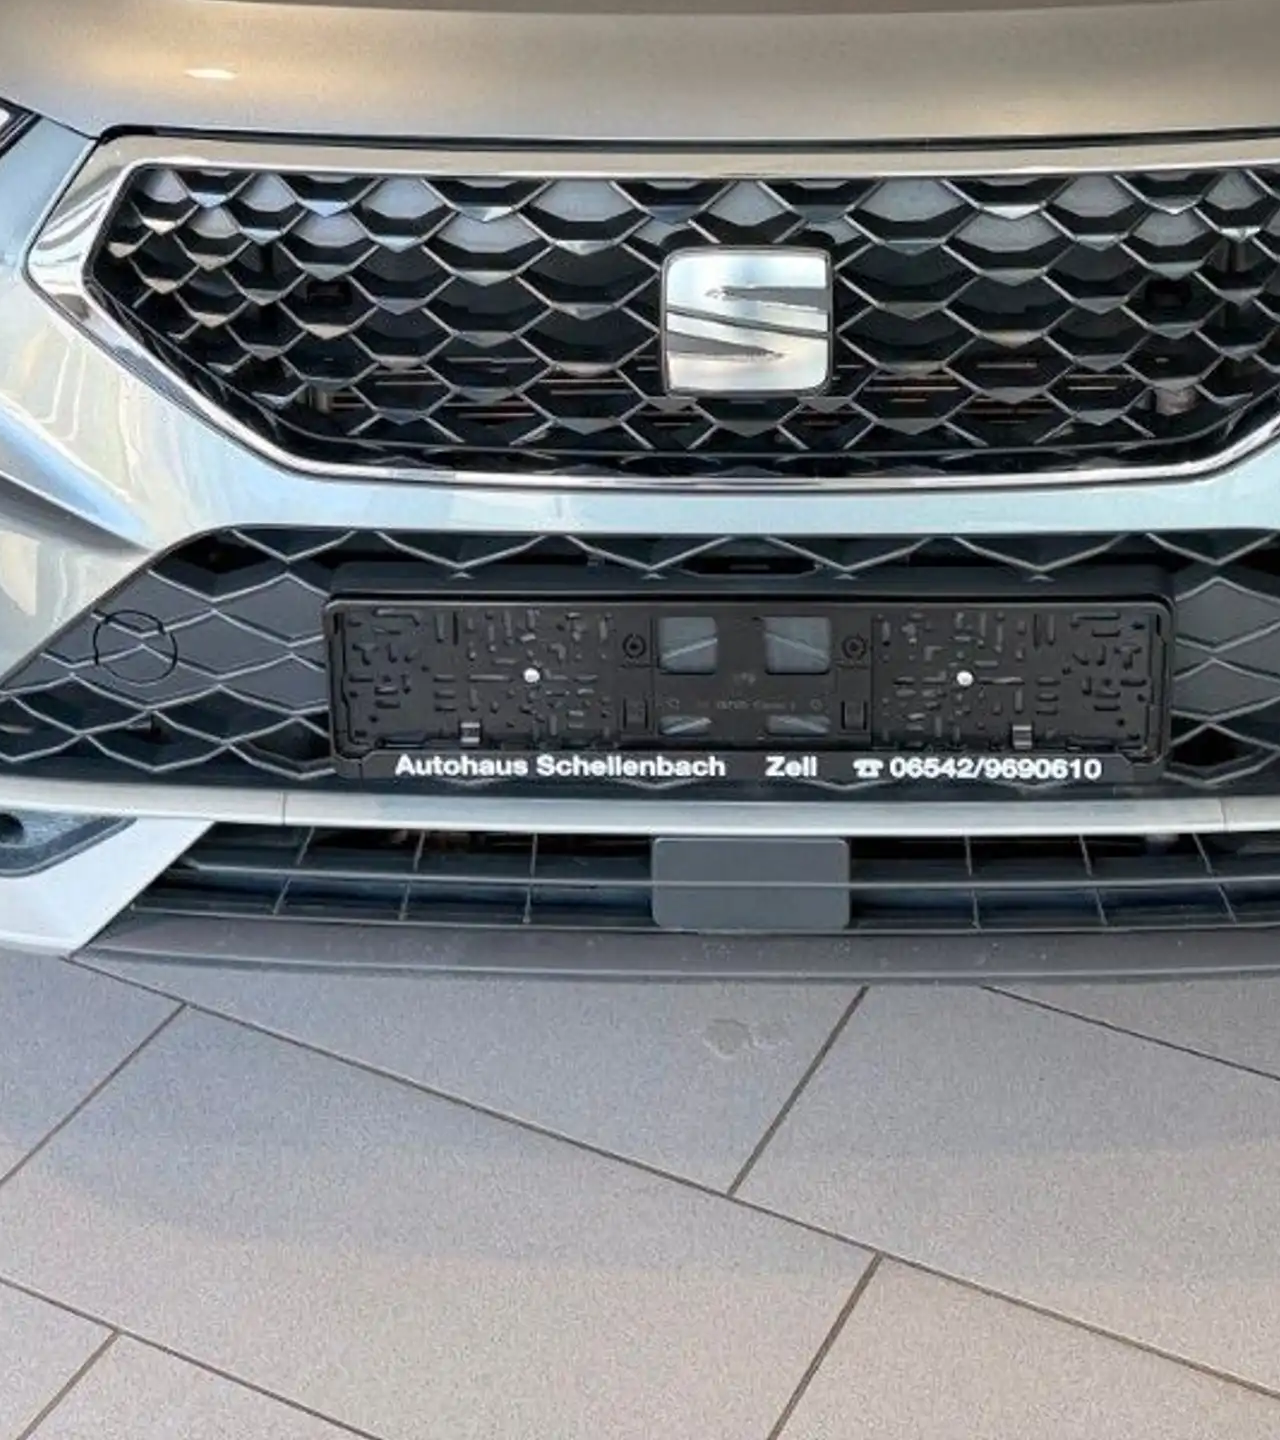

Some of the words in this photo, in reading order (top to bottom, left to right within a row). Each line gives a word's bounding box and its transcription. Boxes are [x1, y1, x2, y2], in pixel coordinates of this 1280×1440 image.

[394, 753, 529, 777] Autohaus
[535, 753, 727, 778] Schellenbach
[764, 755, 818, 778] Zell
[888, 757, 1103, 780] 06542/9690610
